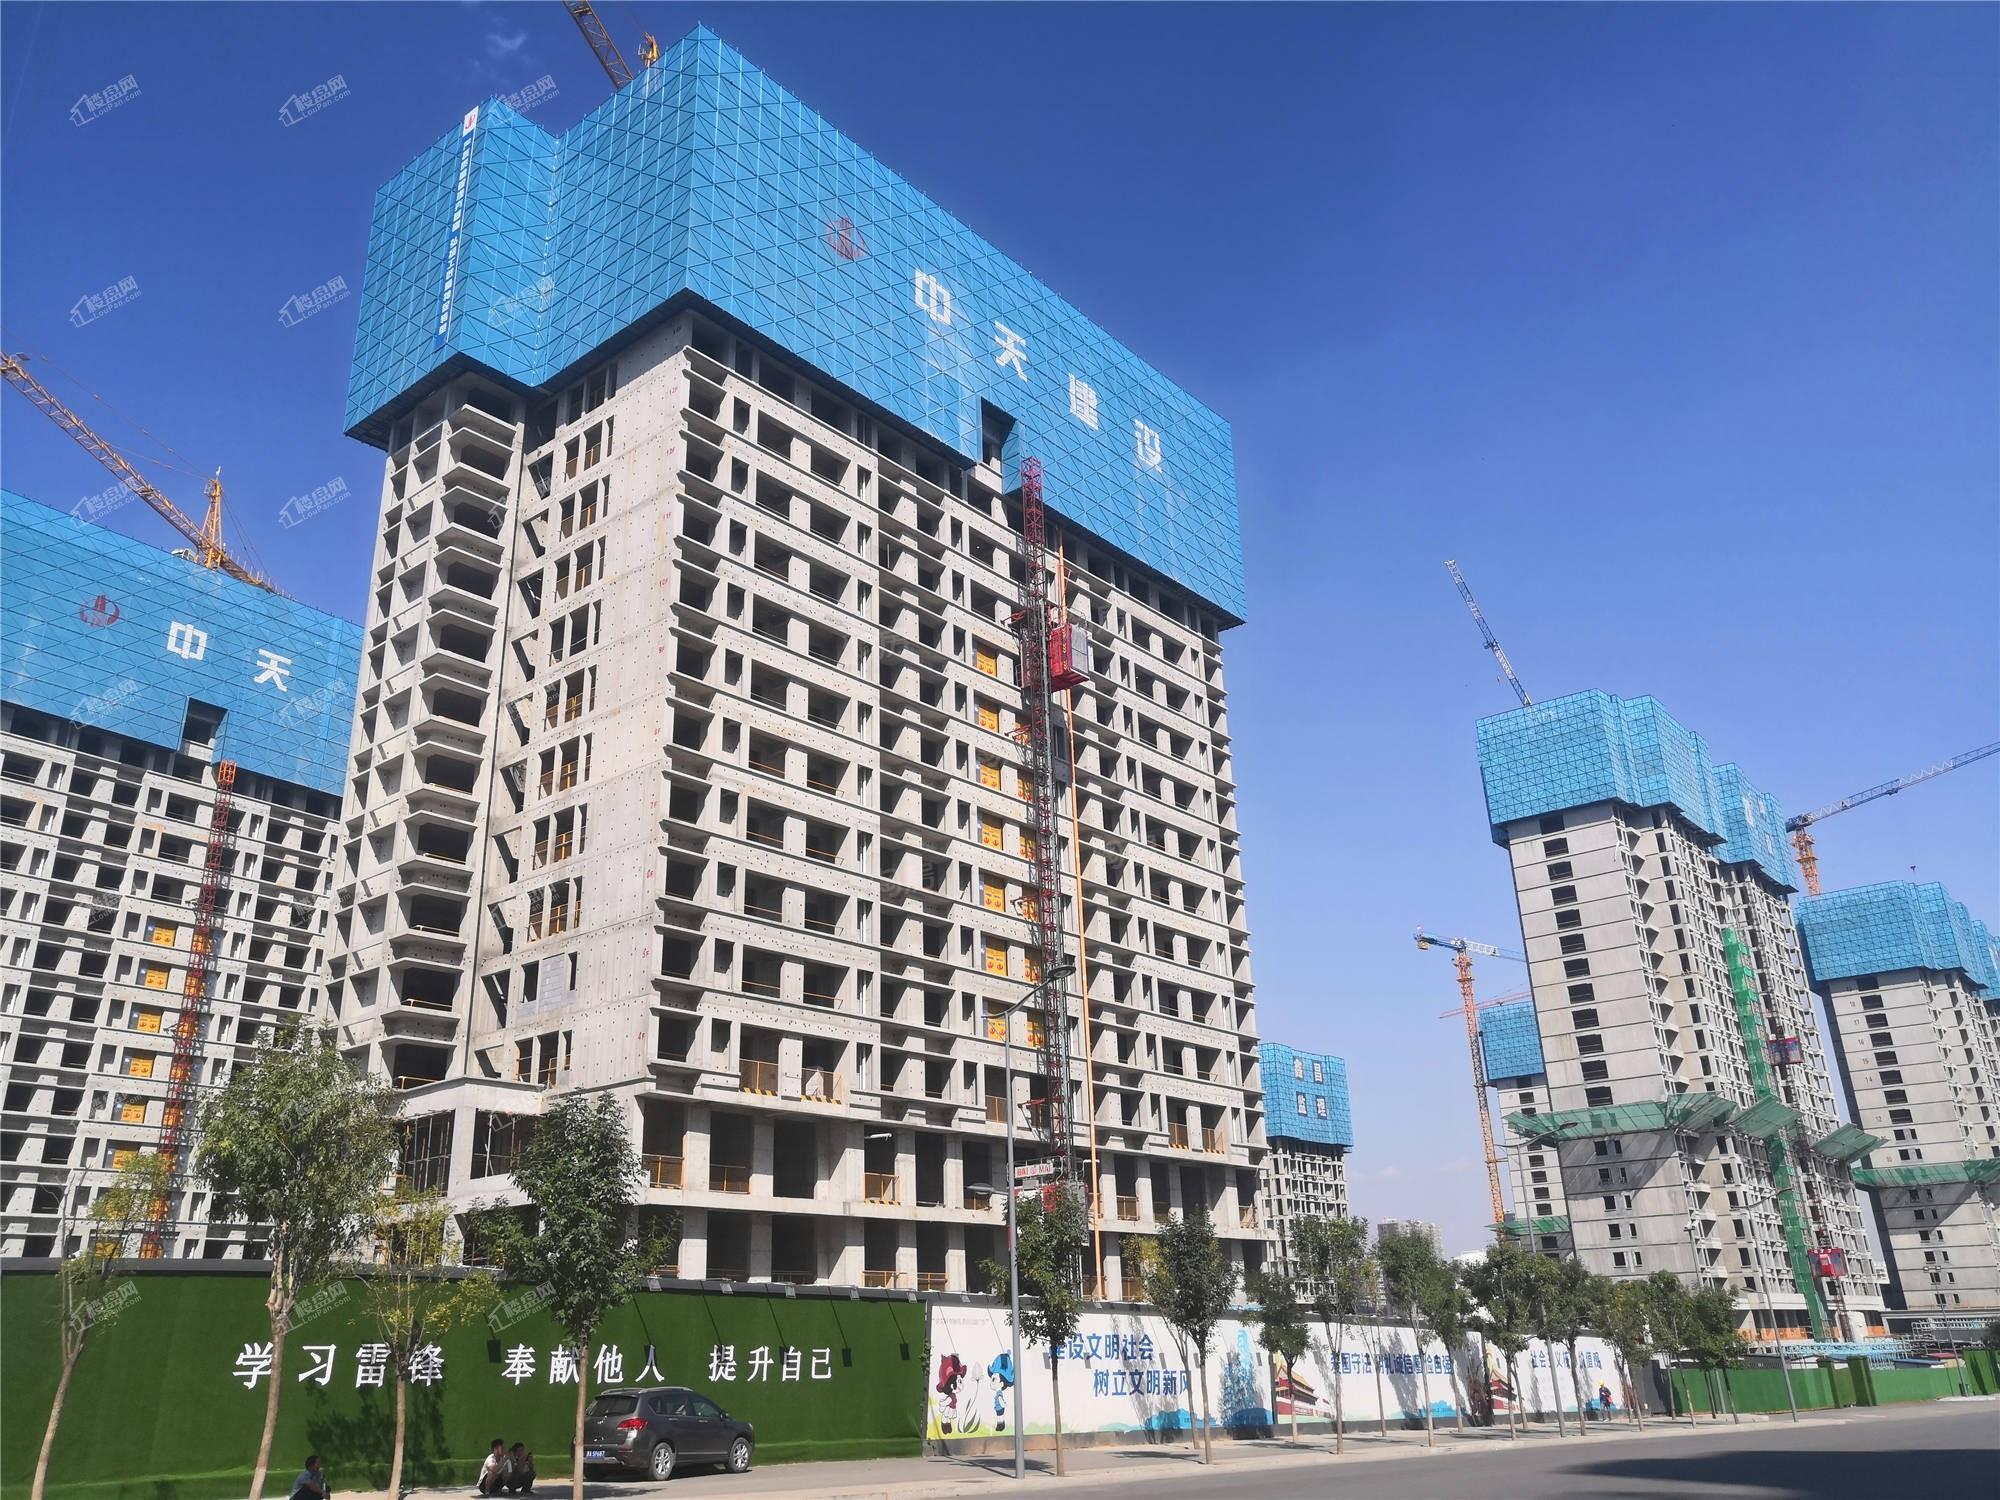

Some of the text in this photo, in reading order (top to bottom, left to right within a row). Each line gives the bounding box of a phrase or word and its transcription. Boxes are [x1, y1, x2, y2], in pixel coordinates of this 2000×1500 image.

[915, 268, 1162, 473] 中天建设
[167, 620, 292, 692] 中天
[232, 1341, 833, 1390] 学习雷锋 奉献他人 提升自己
